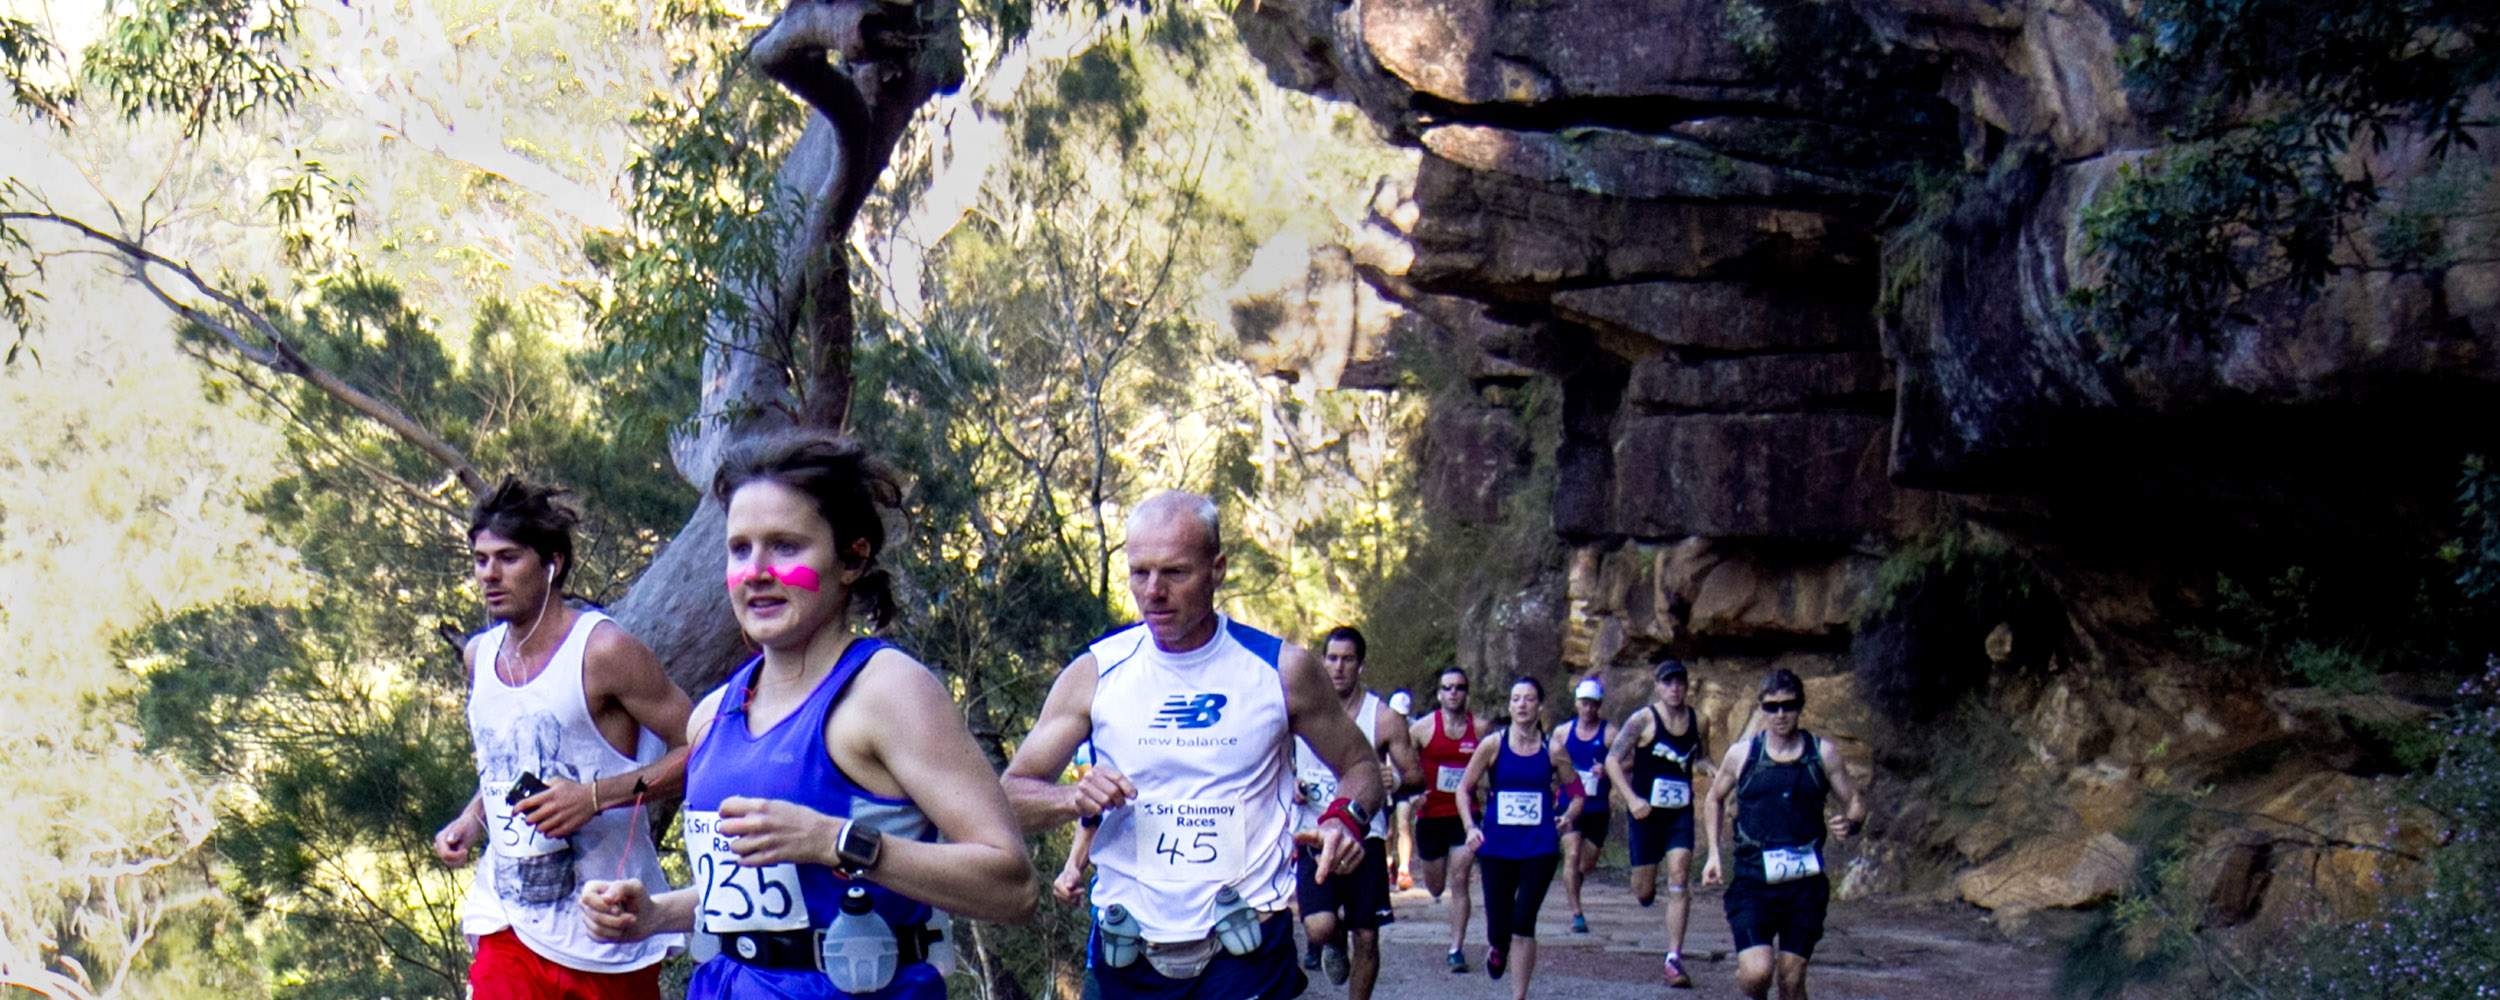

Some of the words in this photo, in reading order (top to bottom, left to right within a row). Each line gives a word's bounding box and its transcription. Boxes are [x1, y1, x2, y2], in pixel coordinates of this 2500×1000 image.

[1138, 737, 1172, 746] new
[1176, 736, 1238, 747] balance
[1658, 789, 1683, 805] 33
[1157, 804, 1173, 815] Sri
[1178, 804, 1235, 816] Chinmoy
[1505, 803, 1539, 819] 236
[694, 818, 710, 833] Sri
[1177, 817, 1216, 827] Races
[1156, 832, 1218, 865] 45
[698, 853, 793, 920] 235
